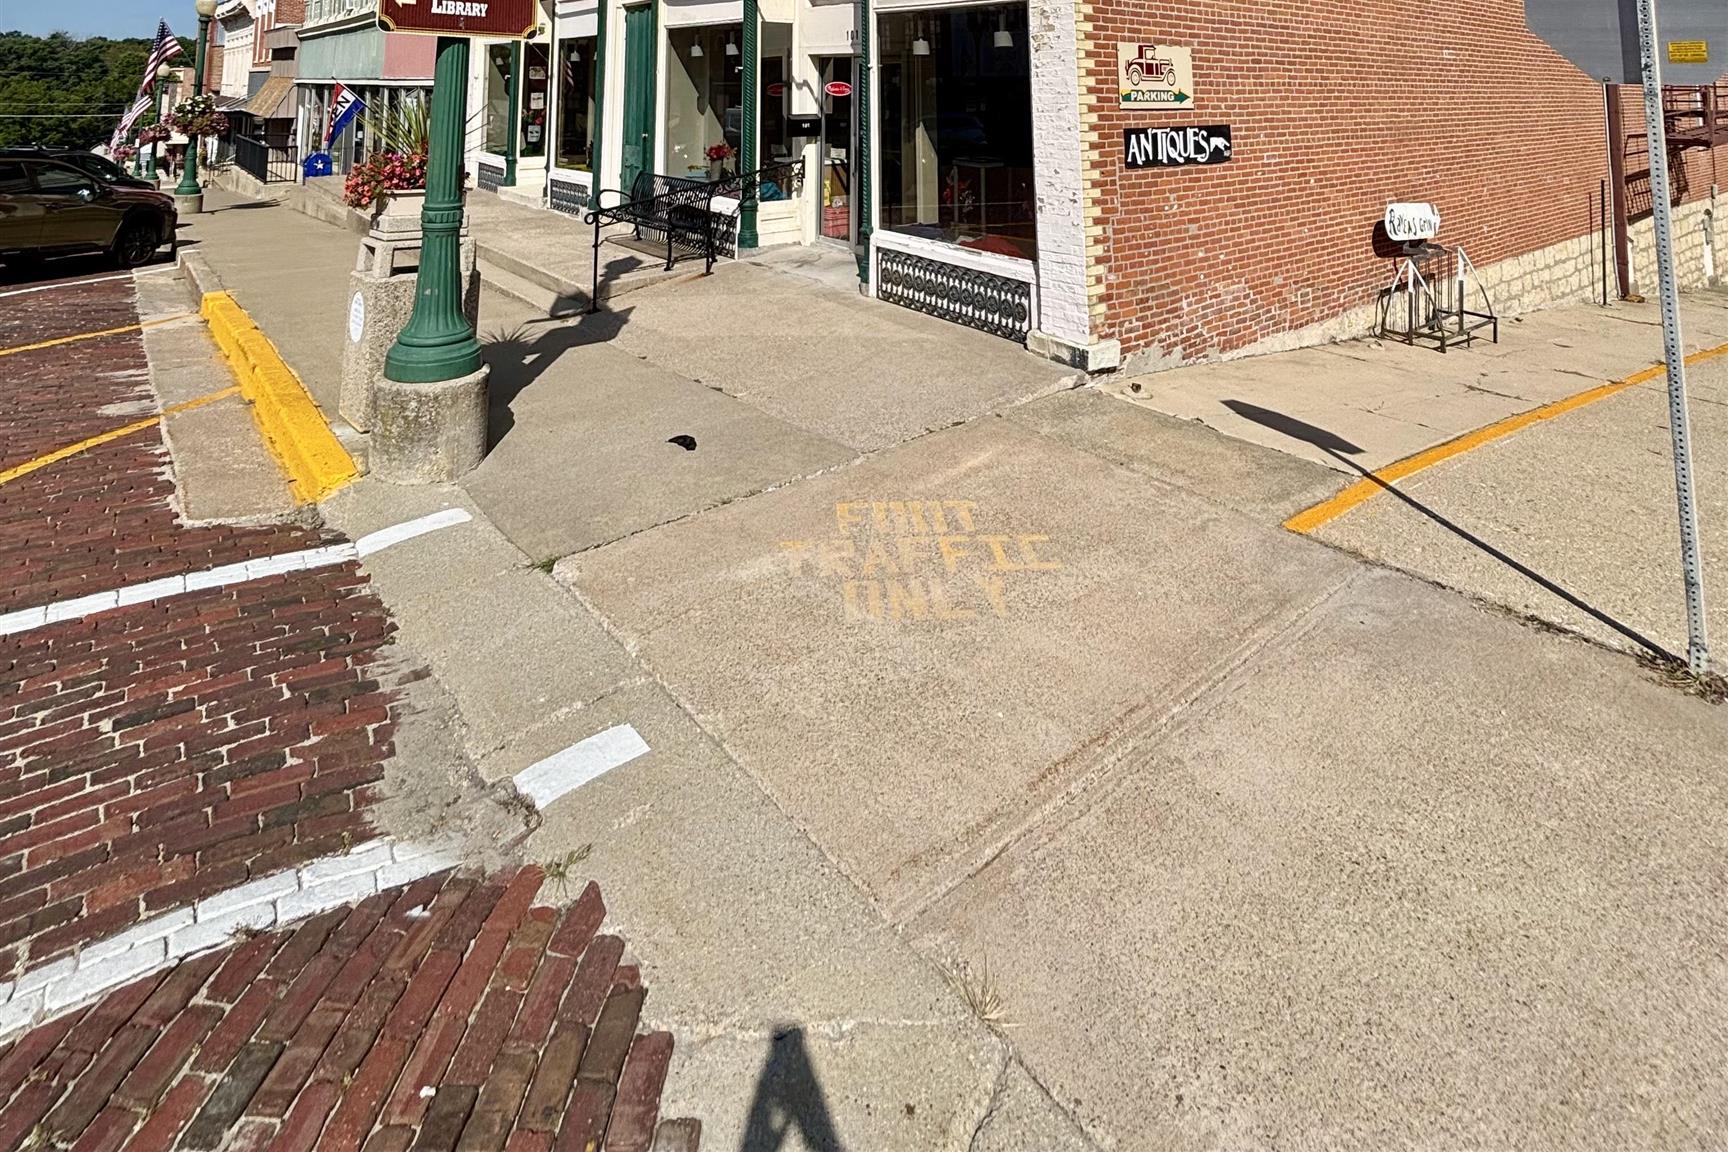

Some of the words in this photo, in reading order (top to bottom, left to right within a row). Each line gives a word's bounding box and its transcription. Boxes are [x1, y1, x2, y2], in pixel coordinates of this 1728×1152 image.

[846, 29, 859, 41] 101
[1131, 91, 1175, 101] PARKING
[1127, 126, 1210, 165] ANTIQUES
